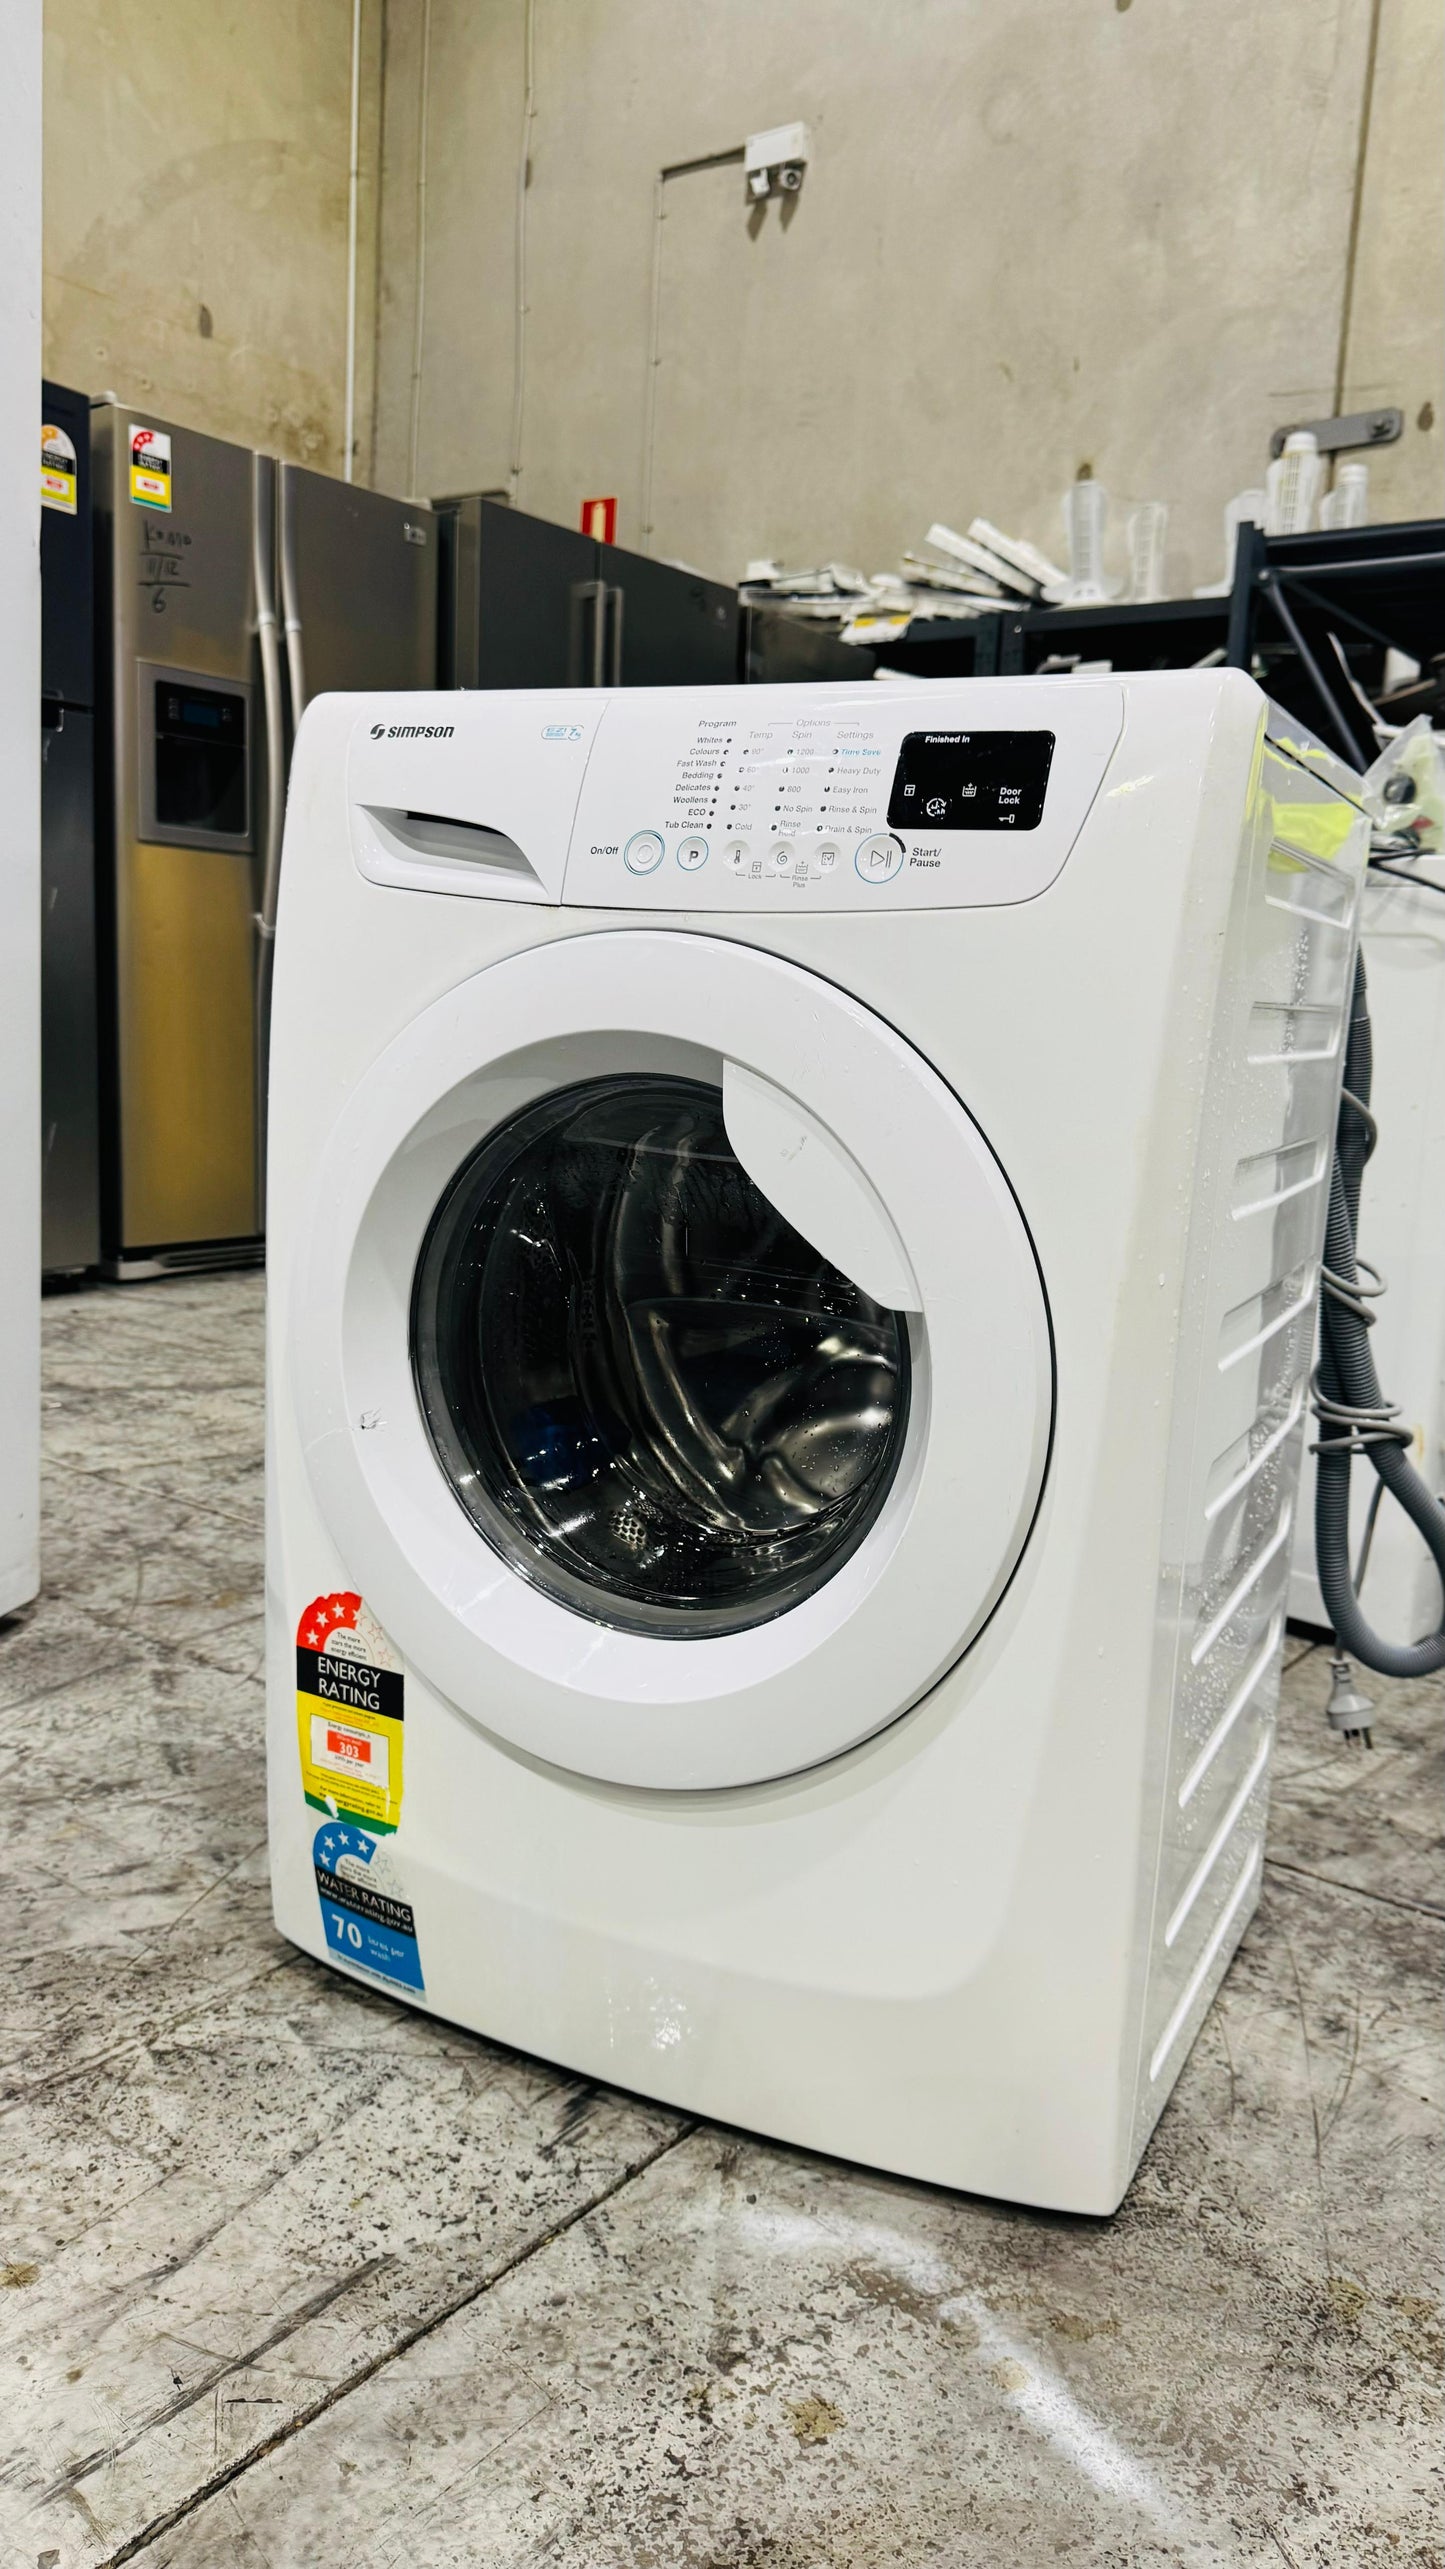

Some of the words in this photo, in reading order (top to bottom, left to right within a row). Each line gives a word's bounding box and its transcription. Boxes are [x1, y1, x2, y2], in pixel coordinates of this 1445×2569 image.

[152, 587, 167, 614] 6
[698, 720, 737, 729] Program
[796, 719, 831, 727] Options
[387, 726, 455, 738] SIMPSON
[749, 731, 773, 740] Temp
[792, 730, 812, 739] Spin
[837, 730, 874, 740] Settings
[924, 735, 960, 743] Finished
[961, 735, 970, 743] In
[677, 759, 694, 767] Fast
[695, 759, 717, 767] Wash
[837, 766, 863, 775] Heavy
[862, 766, 881, 775] Duty
[682, 772, 714, 780] Bedding
[787, 785, 801, 793] 800
[833, 785, 851, 795] Easy
[852, 785, 868, 793] Iron
[1000, 787, 1022, 795] Door
[998, 796, 1020, 804] Lock
[688, 808, 706, 816] ECO
[795, 805, 813, 813] Spin
[828, 805, 850, 813] Rinse
[852, 805, 858, 813] &
[860, 806, 877, 815] Spin
[735, 823, 752, 831] Cold
[780, 820, 801, 828] Rinse
[847, 825, 853, 833] &
[855, 826, 872, 835] Spin
[590, 846, 619, 854] On/Off
[912, 848, 942, 857] Start/
[688, 850, 699, 862] P
[909, 858, 941, 867] Pause
[337, 1631, 346, 1640] The
[317, 1656, 381, 1688] ENERGY
[318, 1678, 380, 1710] RATING
[339, 1741, 360, 1758] 303
[317, 1870, 360, 1900] WATER
[361, 1891, 412, 1923] RATING
[331, 1913, 363, 1949] 70
